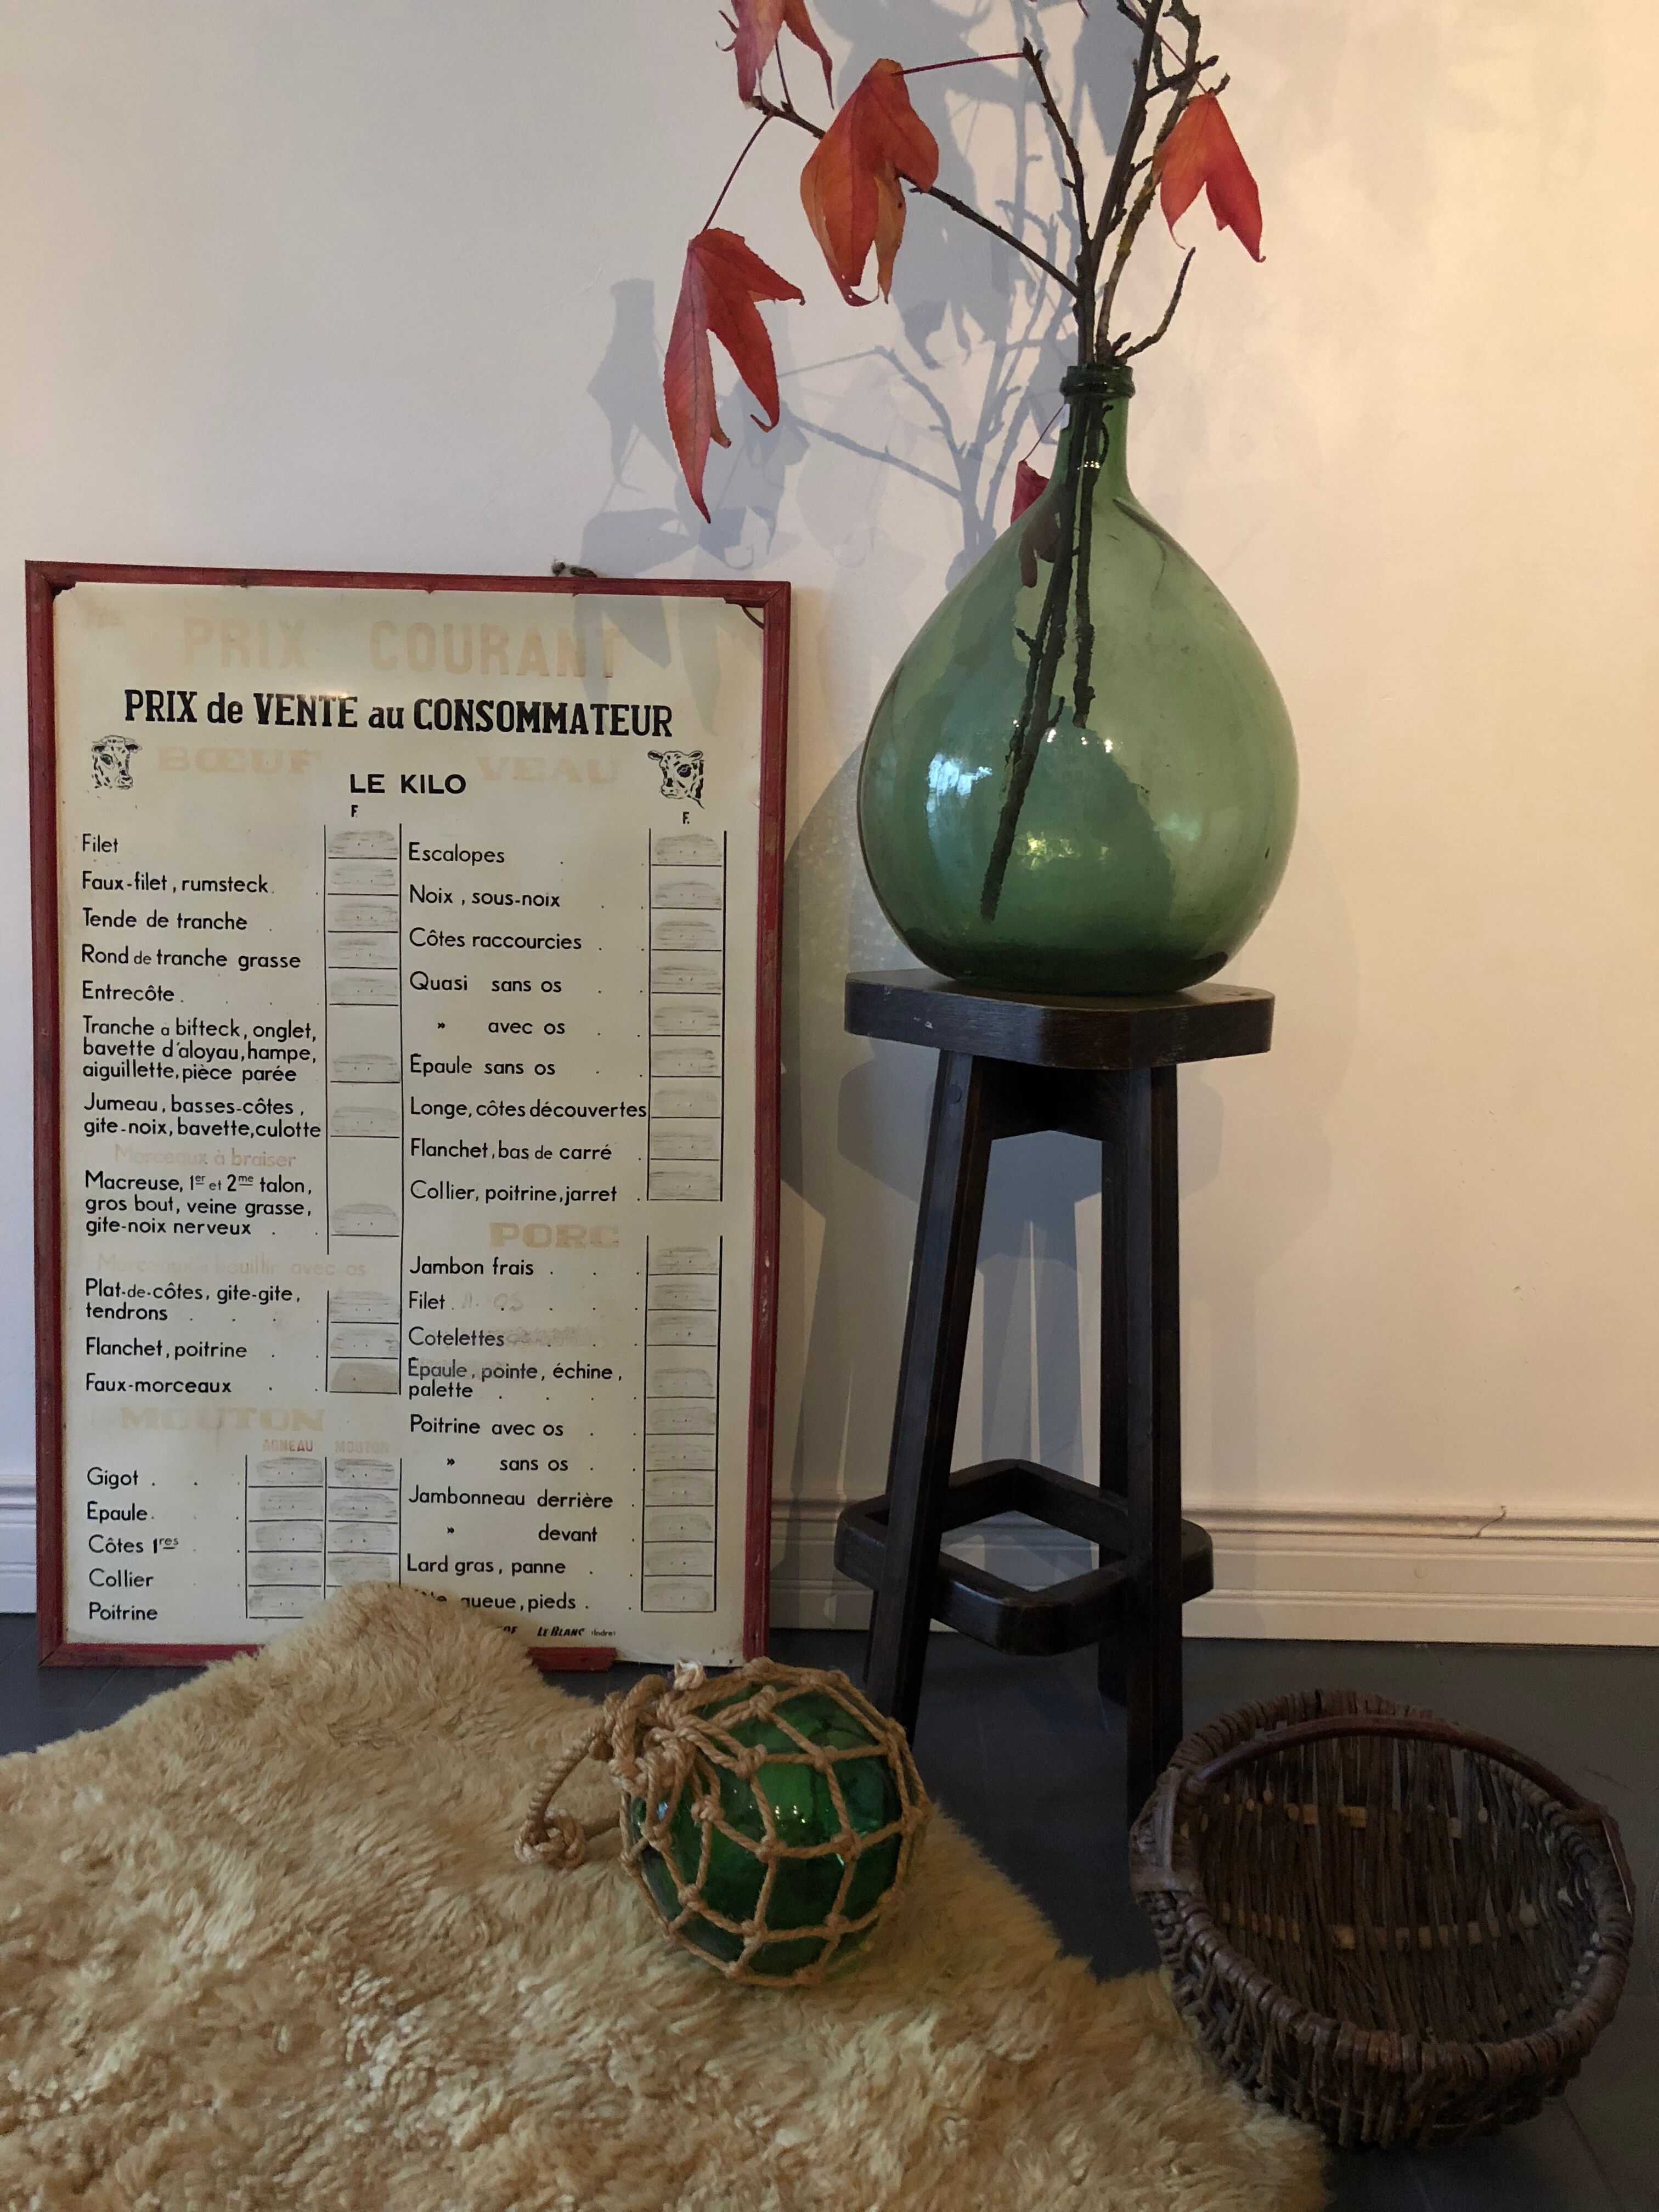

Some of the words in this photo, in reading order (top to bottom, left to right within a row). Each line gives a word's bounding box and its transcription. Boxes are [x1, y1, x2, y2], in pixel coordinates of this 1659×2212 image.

[183, 617, 306, 669] PRIX
[370, 619, 623, 679] COURANT
[124, 689, 198, 723] PRIX
[207, 692, 243, 724] de
[253, 692, 358, 728] VENTE
[368, 707, 404, 729] au
[414, 698, 673, 737] CONSOMMATEUR
[476, 756, 619, 785] VEAU
[350, 774, 385, 793] LE
[400, 774, 466, 794] KILO
[82, 833, 119, 853] Filet
[409, 842, 505, 866] Escalopes
[471, 892, 560, 907] sous-noix
[82, 907, 137, 928] Tende
[146, 909, 169, 928] de
[177, 911, 248, 930] tranche
[409, 927, 465, 947] Côtes
[472, 933, 582, 950] raccourcies
[82, 943, 129, 964] Rond
[133, 950, 152, 965] de
[156, 947, 228, 967] tranche
[238, 955, 301, 972] grasse
[82, 980, 174, 1002] Entrecôte
[409, 970, 467, 991] Quasi
[491, 980, 532, 992] sans
[540, 980, 562, 993] os
[82, 1014, 155, 1038] Tranche
[176, 1017, 247, 1041] bifteck,
[253, 1019, 316, 1043] onglet,
[488, 1022, 533, 1035] avec
[544, 1023, 566, 1035] os
[83, 1036, 155, 1057] bavette
[247, 1040, 316, 1064] hampe,
[83, 1058, 179, 1081] aiguillette,
[182, 1063, 233, 1084] pièce
[242, 1065, 297, 1085] parée
[484, 1063, 524, 1075] sans
[534, 1063, 556, 1075] os
[410, 1096, 472, 1120] Longe,
[476, 1099, 526, 1118] côtes
[529, 1098, 647, 1118] découvertes
[177, 1116, 254, 1138] bavette,
[255, 1119, 321, 1138] culotte
[232, 1148, 296, 1168] braiser
[411, 1137, 495, 1159] Flanchet,
[498, 1139, 529, 1160] bas
[534, 1144, 553, 1160] de
[559, 1144, 612, 1160] carré
[85, 1170, 183, 1193] Macreuse,
[208, 1180, 222, 1191] et
[259, 1174, 312, 1195] talon,
[410, 1180, 479, 1201] Collier,
[486, 1184, 563, 1204] poitrine,
[564, 1186, 617, 1206] jarret
[85, 1199, 127, 1215] gros
[134, 1193, 180, 1215] bout,
[187, 1198, 237, 1215] veine
[245, 1203, 311, 1218] grasse,
[86, 1217, 167, 1237] gite-noix
[173, 1222, 251, 1235] nerveux
[488, 1222, 620, 1249] PORC
[409, 1255, 484, 1274] Jambon
[492, 1256, 534, 1276] frais
[86, 1301, 168, 1321] tendrons
[409, 1290, 445, 1310] Filet
[408, 1327, 505, 1347] Cotelettes
[86, 1336, 170, 1359] Flanchet,
[174, 1341, 247, 1361] poitrine
[86, 1372, 232, 1393] Faux-morceaux
[481, 1363, 545, 1383] pointe,
[552, 1361, 622, 1381] échine,
[409, 1379, 473, 1400] palette
[120, 1407, 325, 1431] MOUTON
[410, 1414, 481, 1435] Poitrine
[492, 1424, 535, 1436] avec
[543, 1424, 563, 1436] os
[499, 1459, 539, 1471] sans
[548, 1459, 568, 1471] os
[87, 1466, 139, 1490] Gigot
[408, 1484, 525, 1506] Jambonneau
[537, 1488, 613, 1508] derrière
[538, 1522, 597, 1542] devant
[88, 1534, 144, 1554] Côtes
[407, 1553, 448, 1573] Lard
[511, 1562, 566, 1577] panne
[89, 1568, 154, 1588] Collier
[89, 1601, 158, 1621] Poitrine
[528, 1591, 576, 1613] pieds
